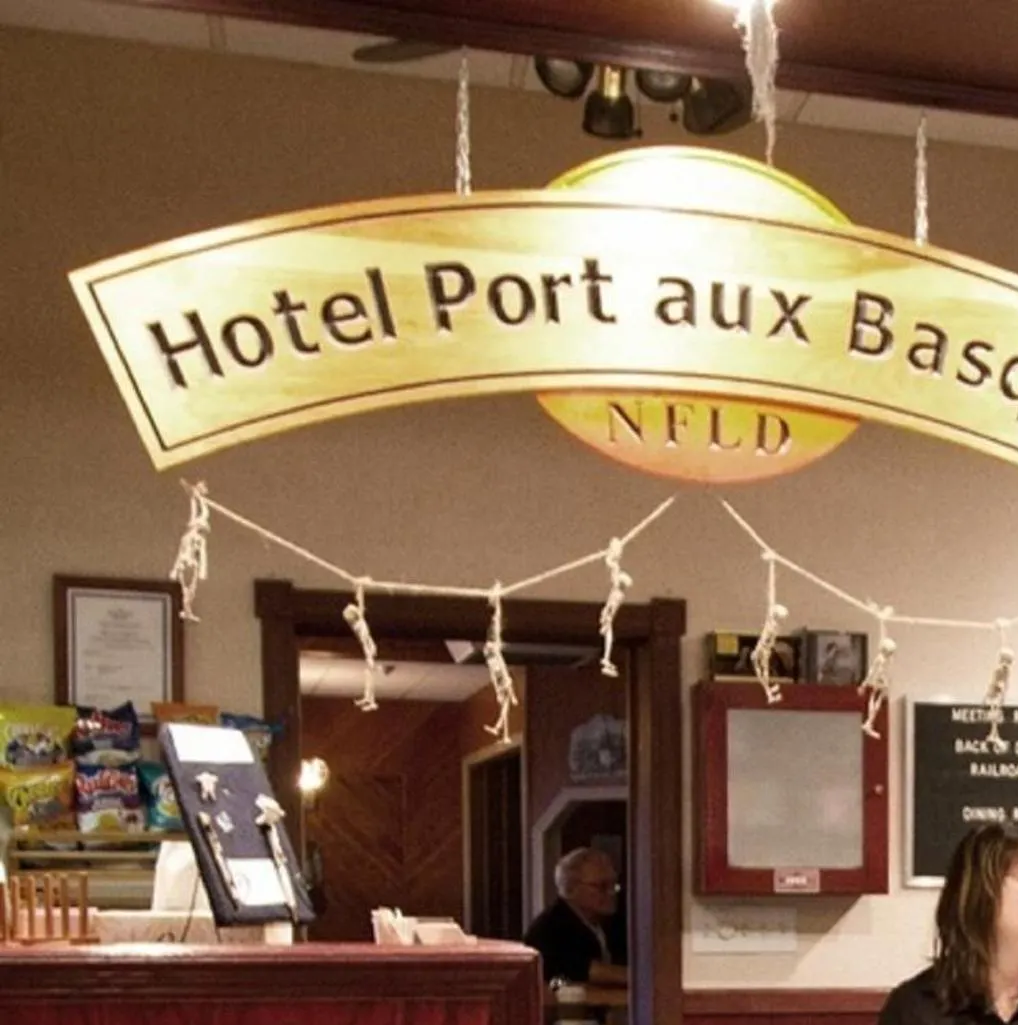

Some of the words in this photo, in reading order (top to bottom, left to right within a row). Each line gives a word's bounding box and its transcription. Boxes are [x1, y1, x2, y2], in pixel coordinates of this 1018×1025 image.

[146, 267, 398, 389] Hotel
[424, 257, 617, 334] Port
[654, 274, 812, 343] aux
[607, 401, 793, 457] NFLD
[951, 707, 1004, 724] MEETIG
[955, 738, 989, 754] BACK
[962, 805, 1006, 822] DINING
